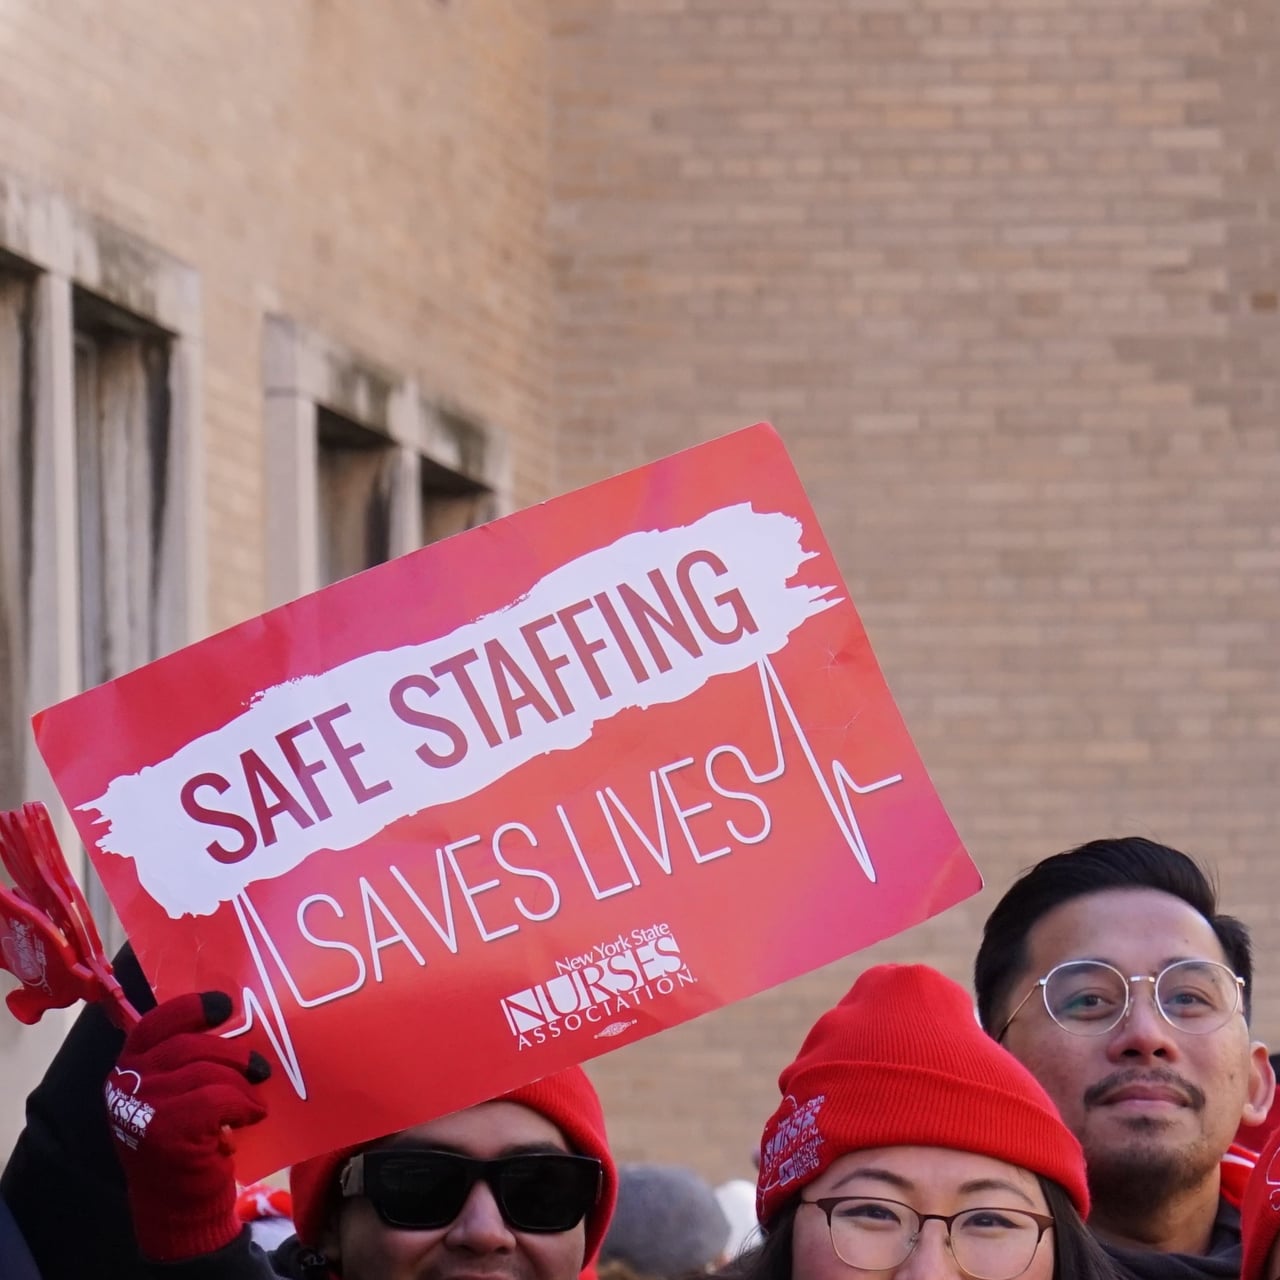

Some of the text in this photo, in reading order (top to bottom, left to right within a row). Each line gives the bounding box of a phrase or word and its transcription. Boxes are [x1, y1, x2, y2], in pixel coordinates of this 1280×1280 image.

[180, 550, 759, 866] SAFE STAFFING
[297, 744, 774, 1008] SAVES LIVES
[500, 932, 687, 1036] NURSES
[555, 922, 671, 975] New York State
[518, 964, 696, 1051] ASSOCIATION
